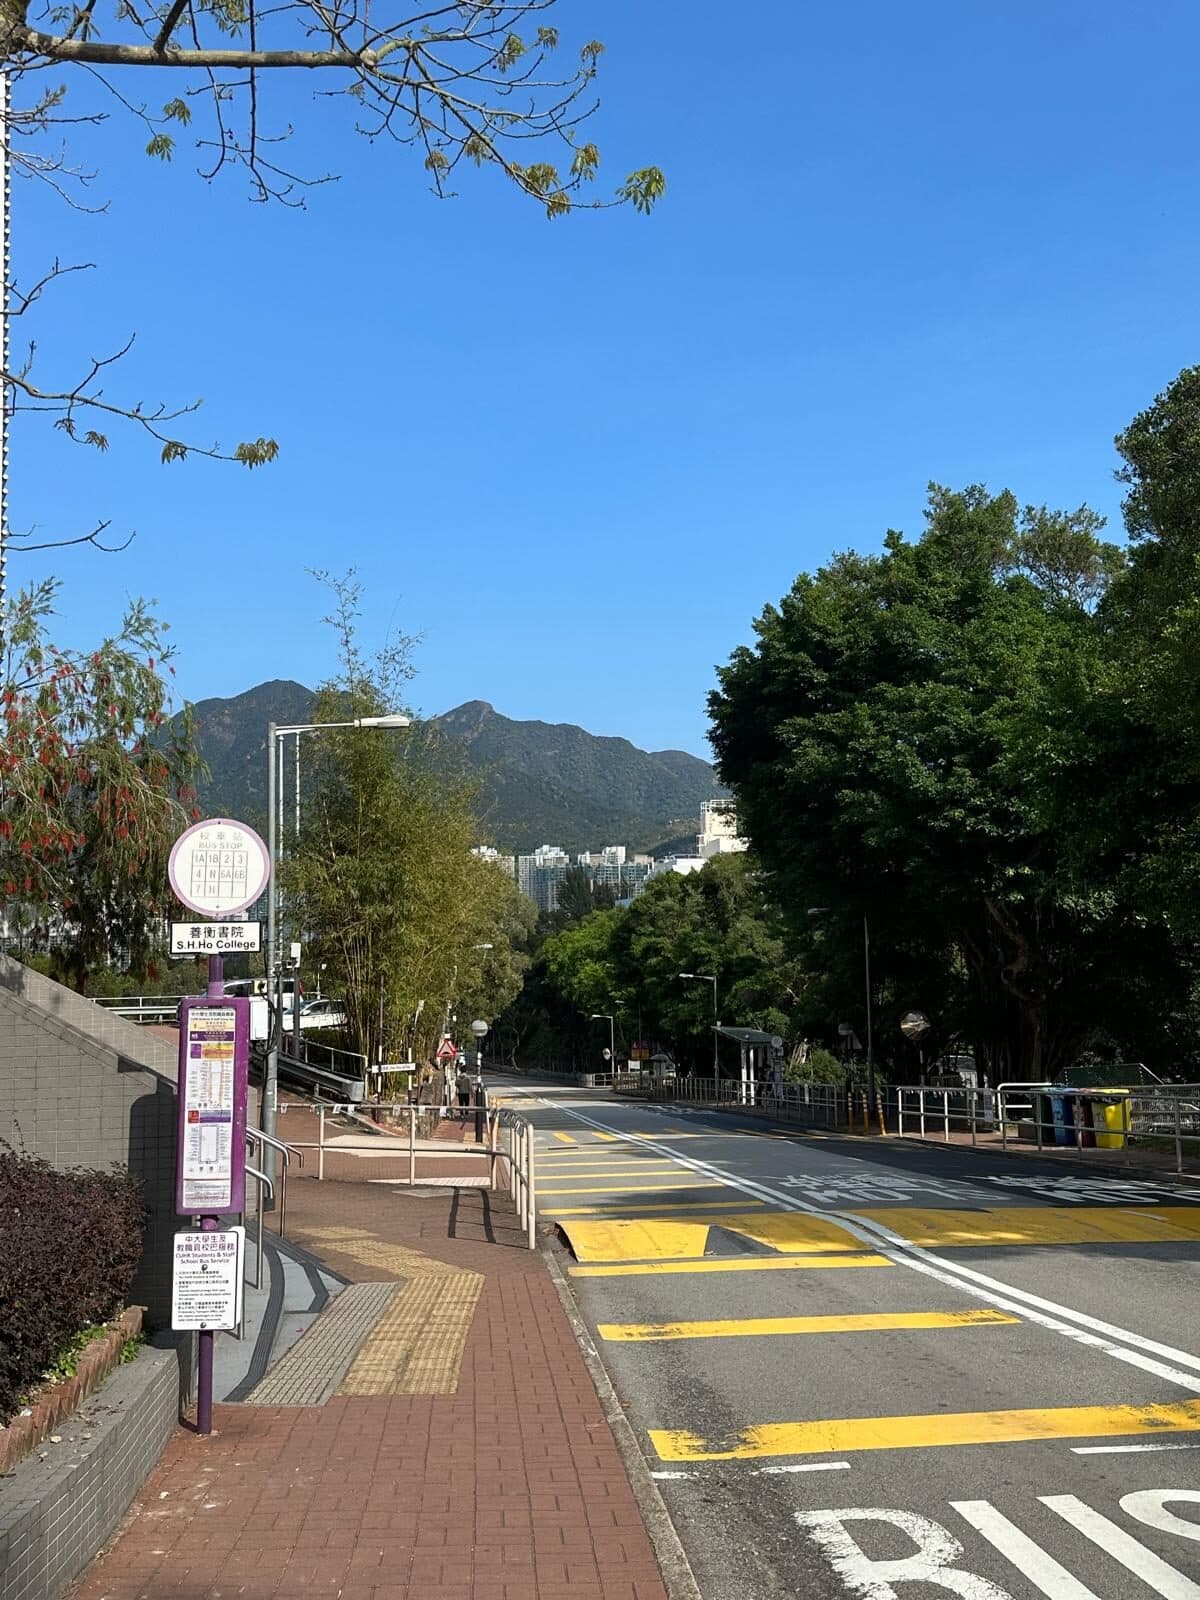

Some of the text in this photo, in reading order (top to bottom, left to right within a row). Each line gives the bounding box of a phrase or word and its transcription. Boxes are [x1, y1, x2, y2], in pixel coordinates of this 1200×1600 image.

[195, 854, 205, 863] 1A
[208, 854, 219, 863] 1B
[224, 854, 230, 864] 2
[190, 926, 244, 938] 善衡書院
[176, 939, 256, 950] S.H.Ho College
[801, 1188, 1011, 1203] SLOW
